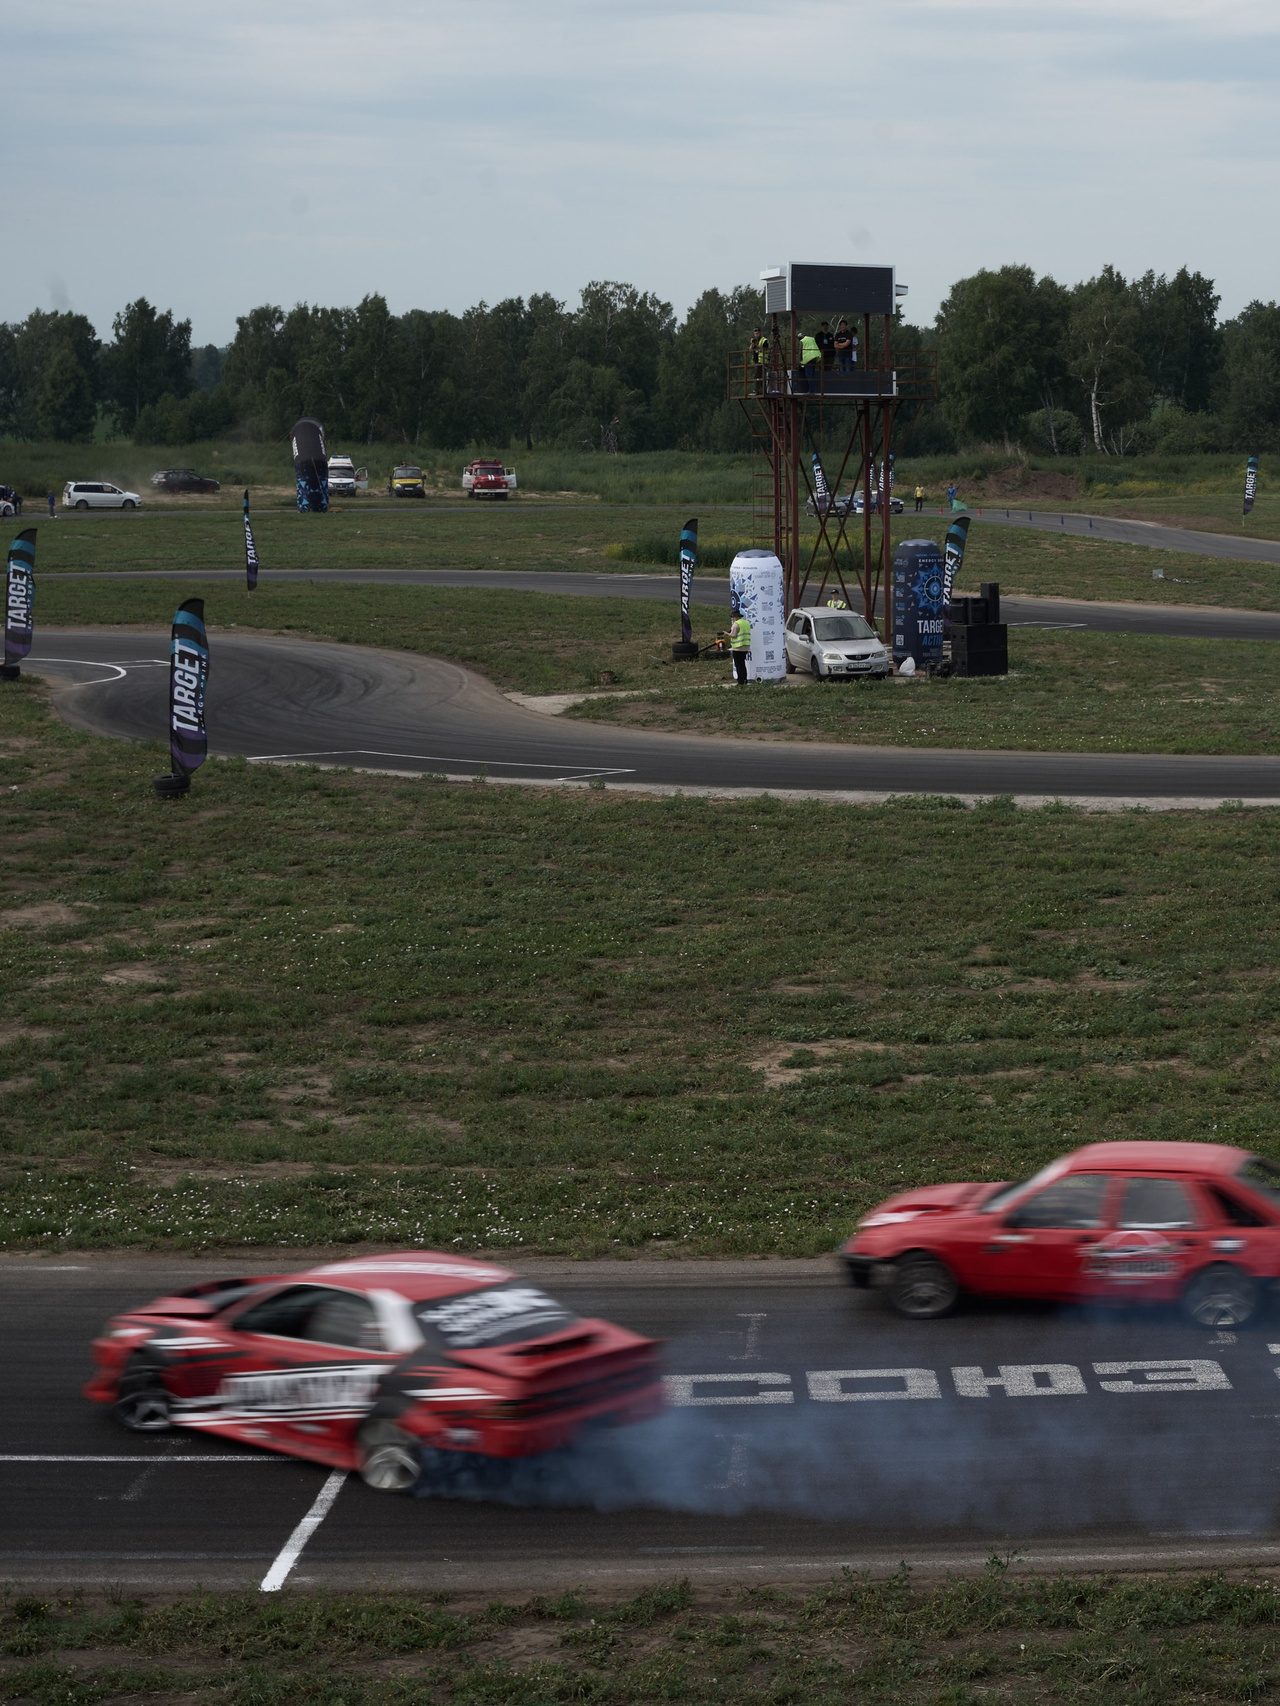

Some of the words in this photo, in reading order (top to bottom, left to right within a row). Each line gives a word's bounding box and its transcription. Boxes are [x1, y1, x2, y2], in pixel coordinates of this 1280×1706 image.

[812, 463, 826, 498] TARGET
[1244, 467, 1256, 499] TARGET
[7, 561, 27, 630] TARGET
[681, 550, 691, 615] TARGET
[942, 543, 959, 606] TARGET
[173, 638, 200, 732] TARGET
[663, 1359, 1234, 1407] СОЮЗ
